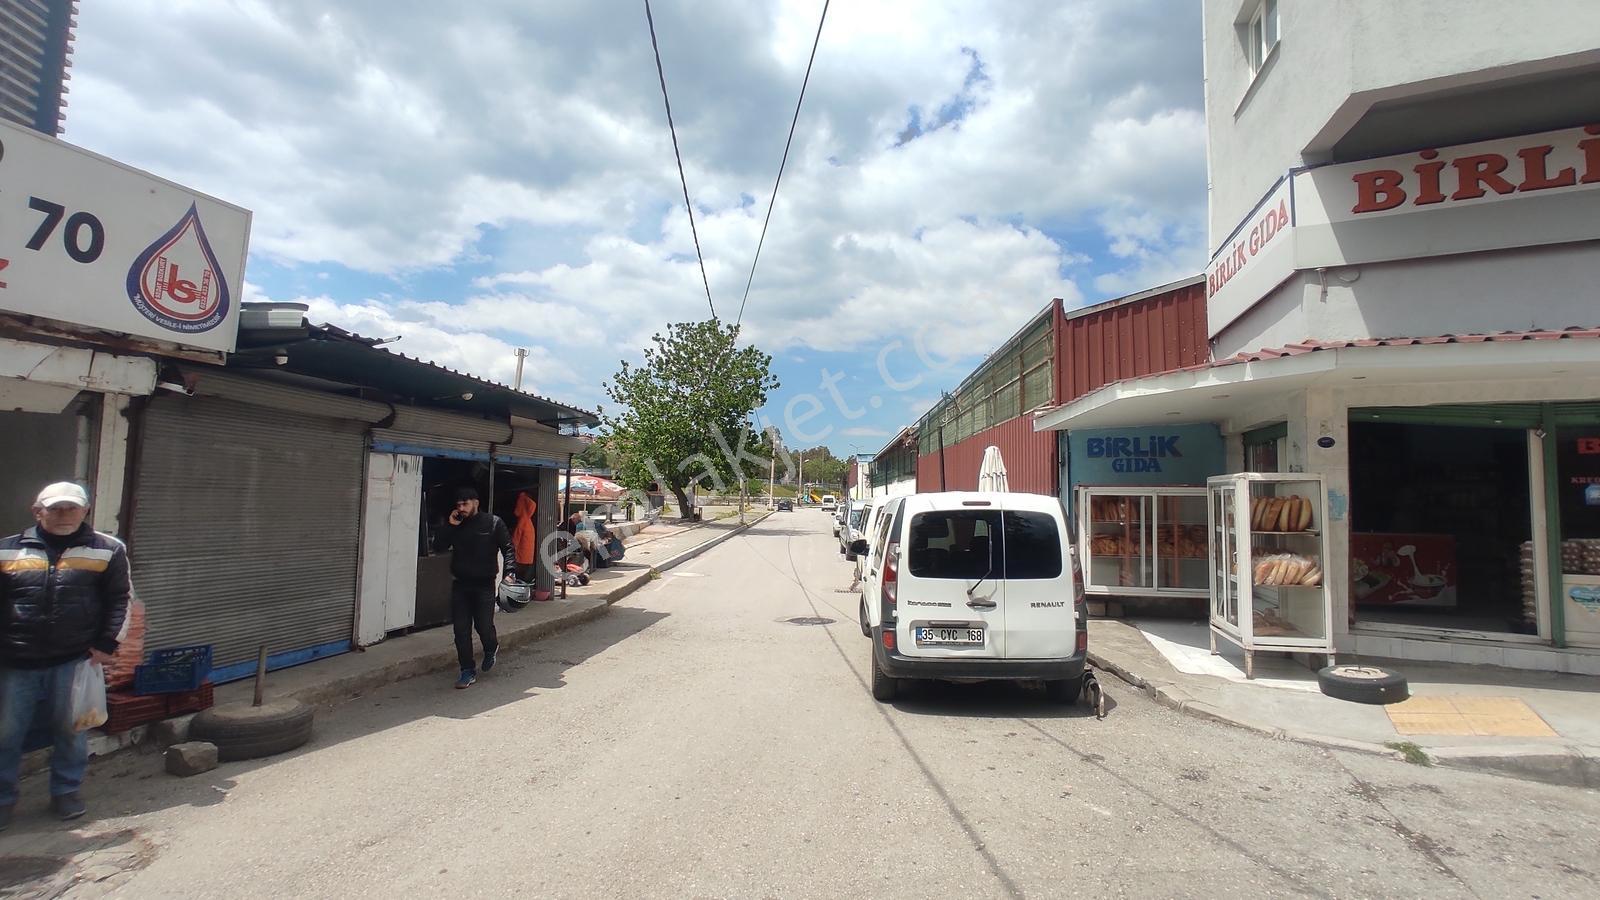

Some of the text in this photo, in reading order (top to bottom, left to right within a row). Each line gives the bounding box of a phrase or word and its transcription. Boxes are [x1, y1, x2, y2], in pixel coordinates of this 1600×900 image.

[25, 196, 105, 263] 70
[1209, 198, 1288, 298] BİRLİK GIDA
[1112, 458, 1163, 473] GIDA
[922, 629, 982, 641] 35 CYC 168
